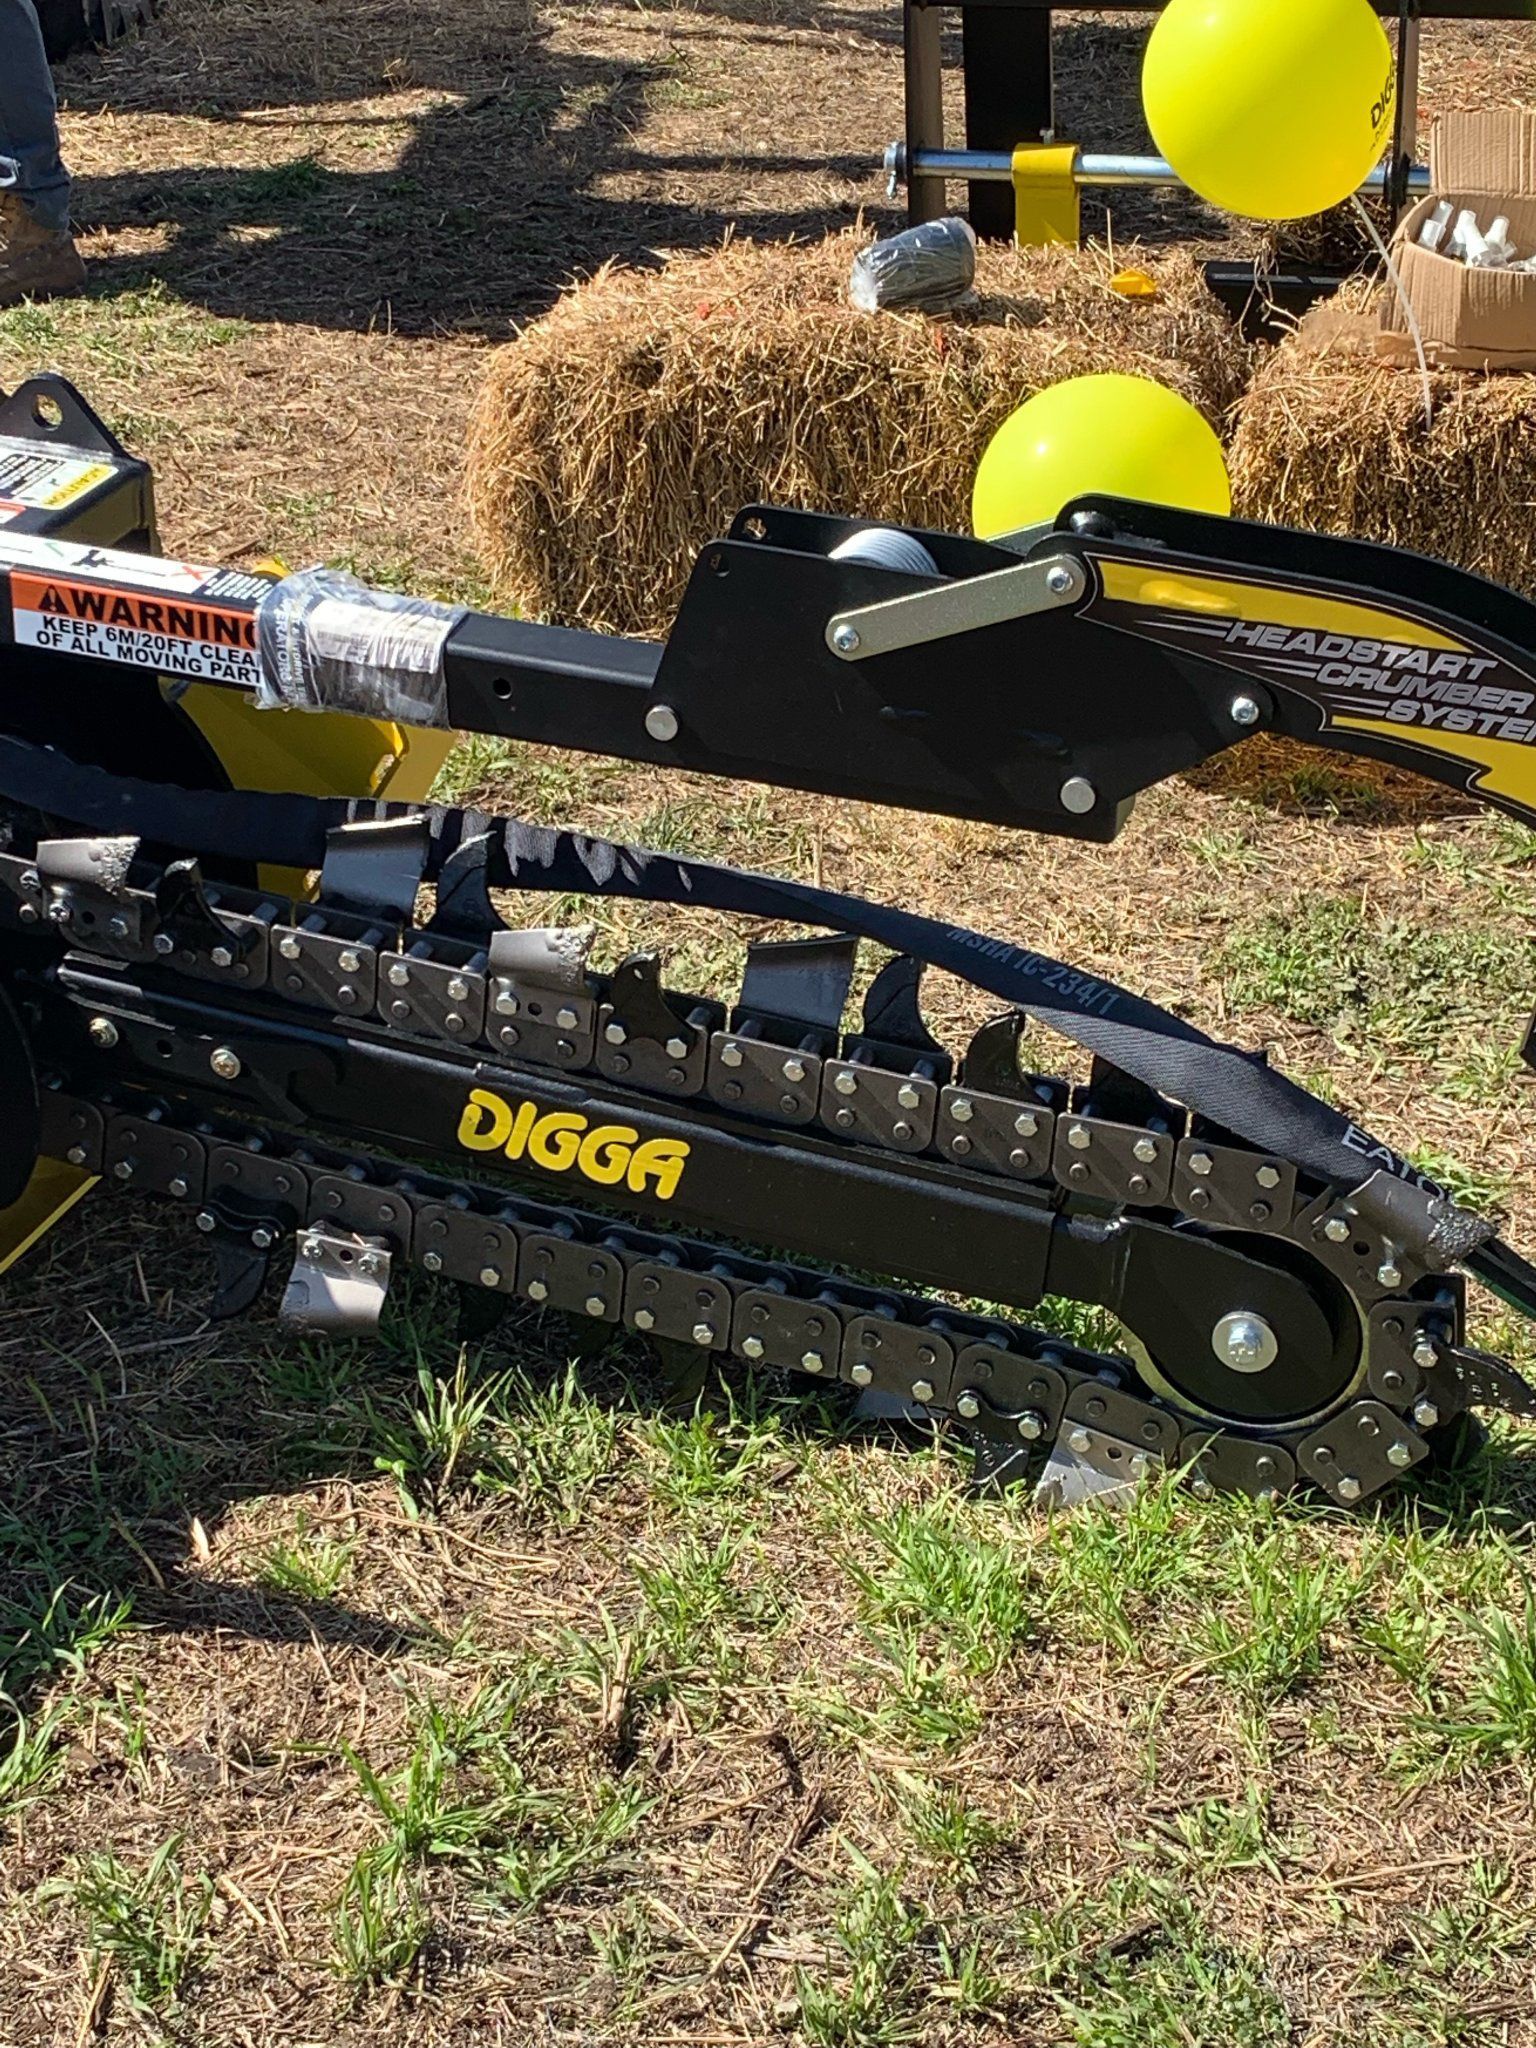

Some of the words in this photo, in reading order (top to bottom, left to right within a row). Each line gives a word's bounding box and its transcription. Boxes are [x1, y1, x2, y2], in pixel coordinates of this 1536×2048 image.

[37, 631, 68, 647] OF
[71, 639, 110, 656] ALL
[117, 645, 201, 673] MOVING
[210, 664, 262, 684] PART
[43, 616, 98, 637] KEEP
[105, 627, 192, 655] 6M/20FT
[200, 645, 254, 668] CLEA
[1226, 622, 1498, 680] HEADSTART
[1316, 664, 1535, 714] CRUMBER
[946, 929, 1017, 963] MSHA
[1013, 954, 1120, 1015] IC-234/1
[458, 1089, 690, 1200] DIGGA
[1341, 1124, 1445, 1200] EATO
